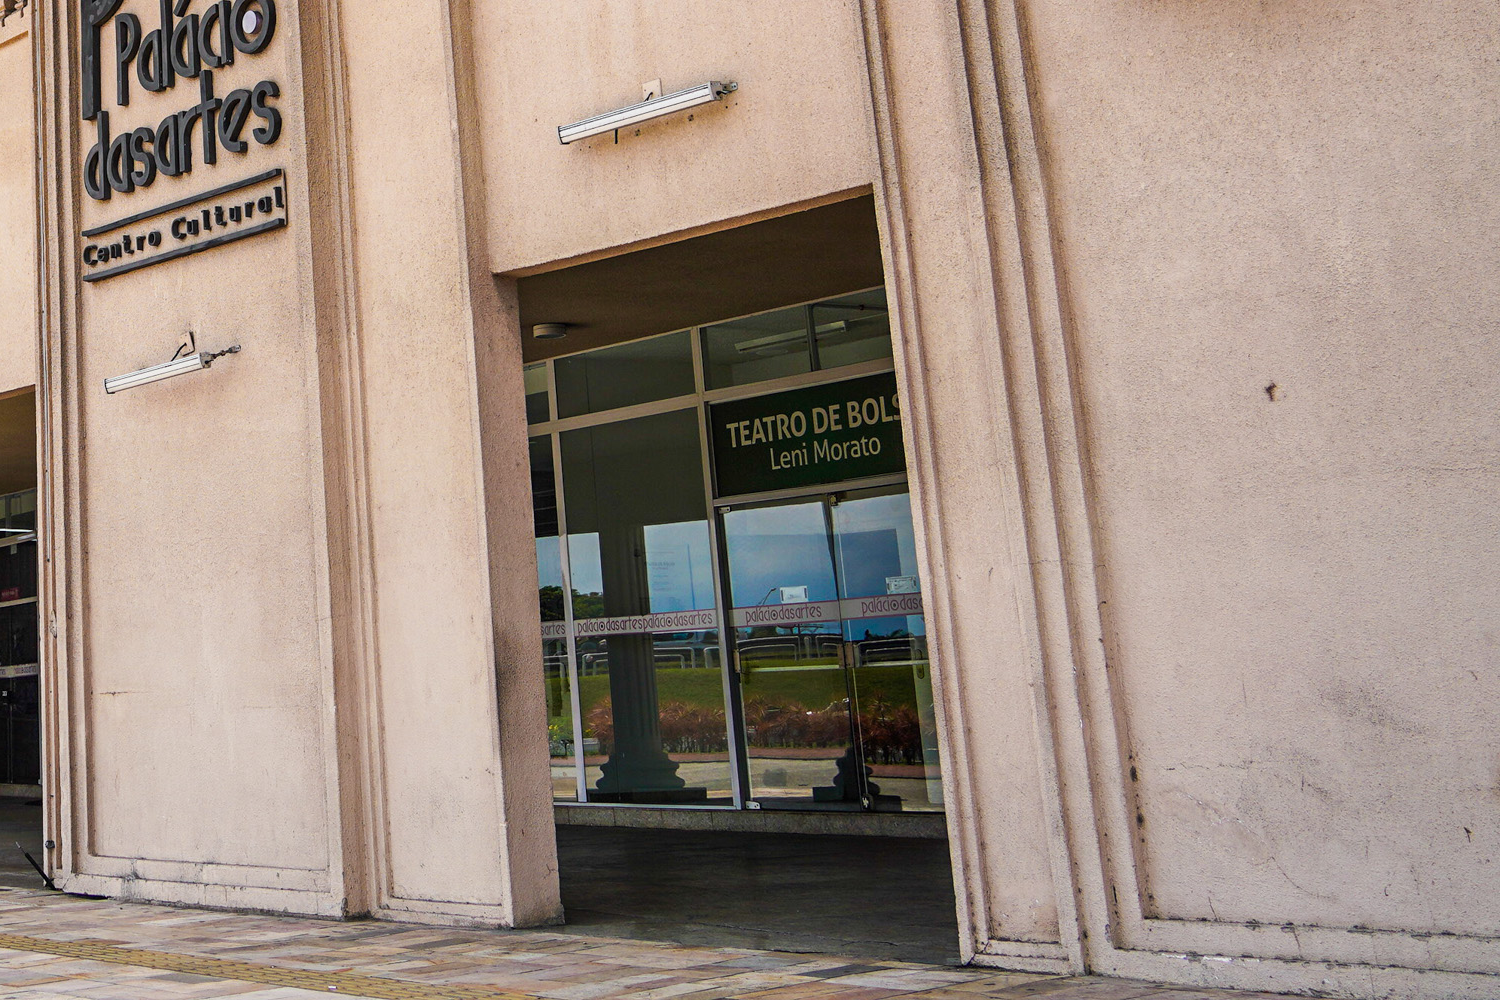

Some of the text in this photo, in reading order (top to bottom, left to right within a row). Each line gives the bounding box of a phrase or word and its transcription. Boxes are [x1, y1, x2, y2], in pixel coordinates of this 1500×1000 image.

[83, 186, 284, 265] Centro Cultural
[726, 410, 807, 448] TEATRO
[812, 404, 842, 434] DE
[770, 435, 881, 470] Leni Morato
